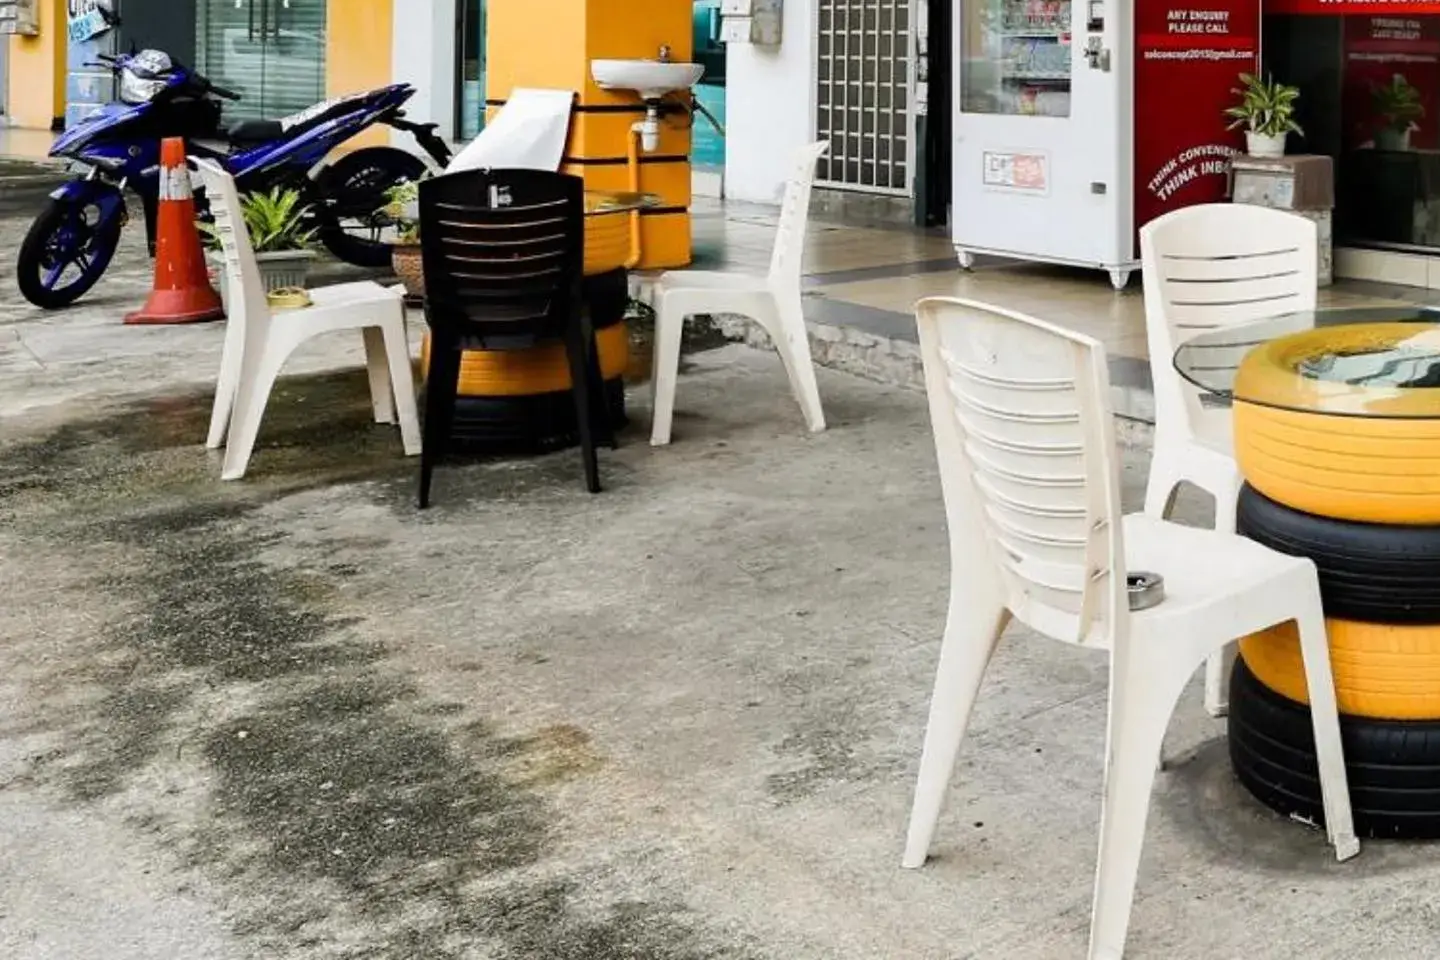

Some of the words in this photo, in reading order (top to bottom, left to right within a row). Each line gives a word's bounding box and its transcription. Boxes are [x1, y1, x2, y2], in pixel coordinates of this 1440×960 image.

[1167, 9, 1187, 20] ANY
[1168, 22, 1204, 33] PLEASE
[1205, 22, 1229, 33] CALL
[1147, 159, 1178, 192] THINK
[1157, 165, 1198, 202] THINK
